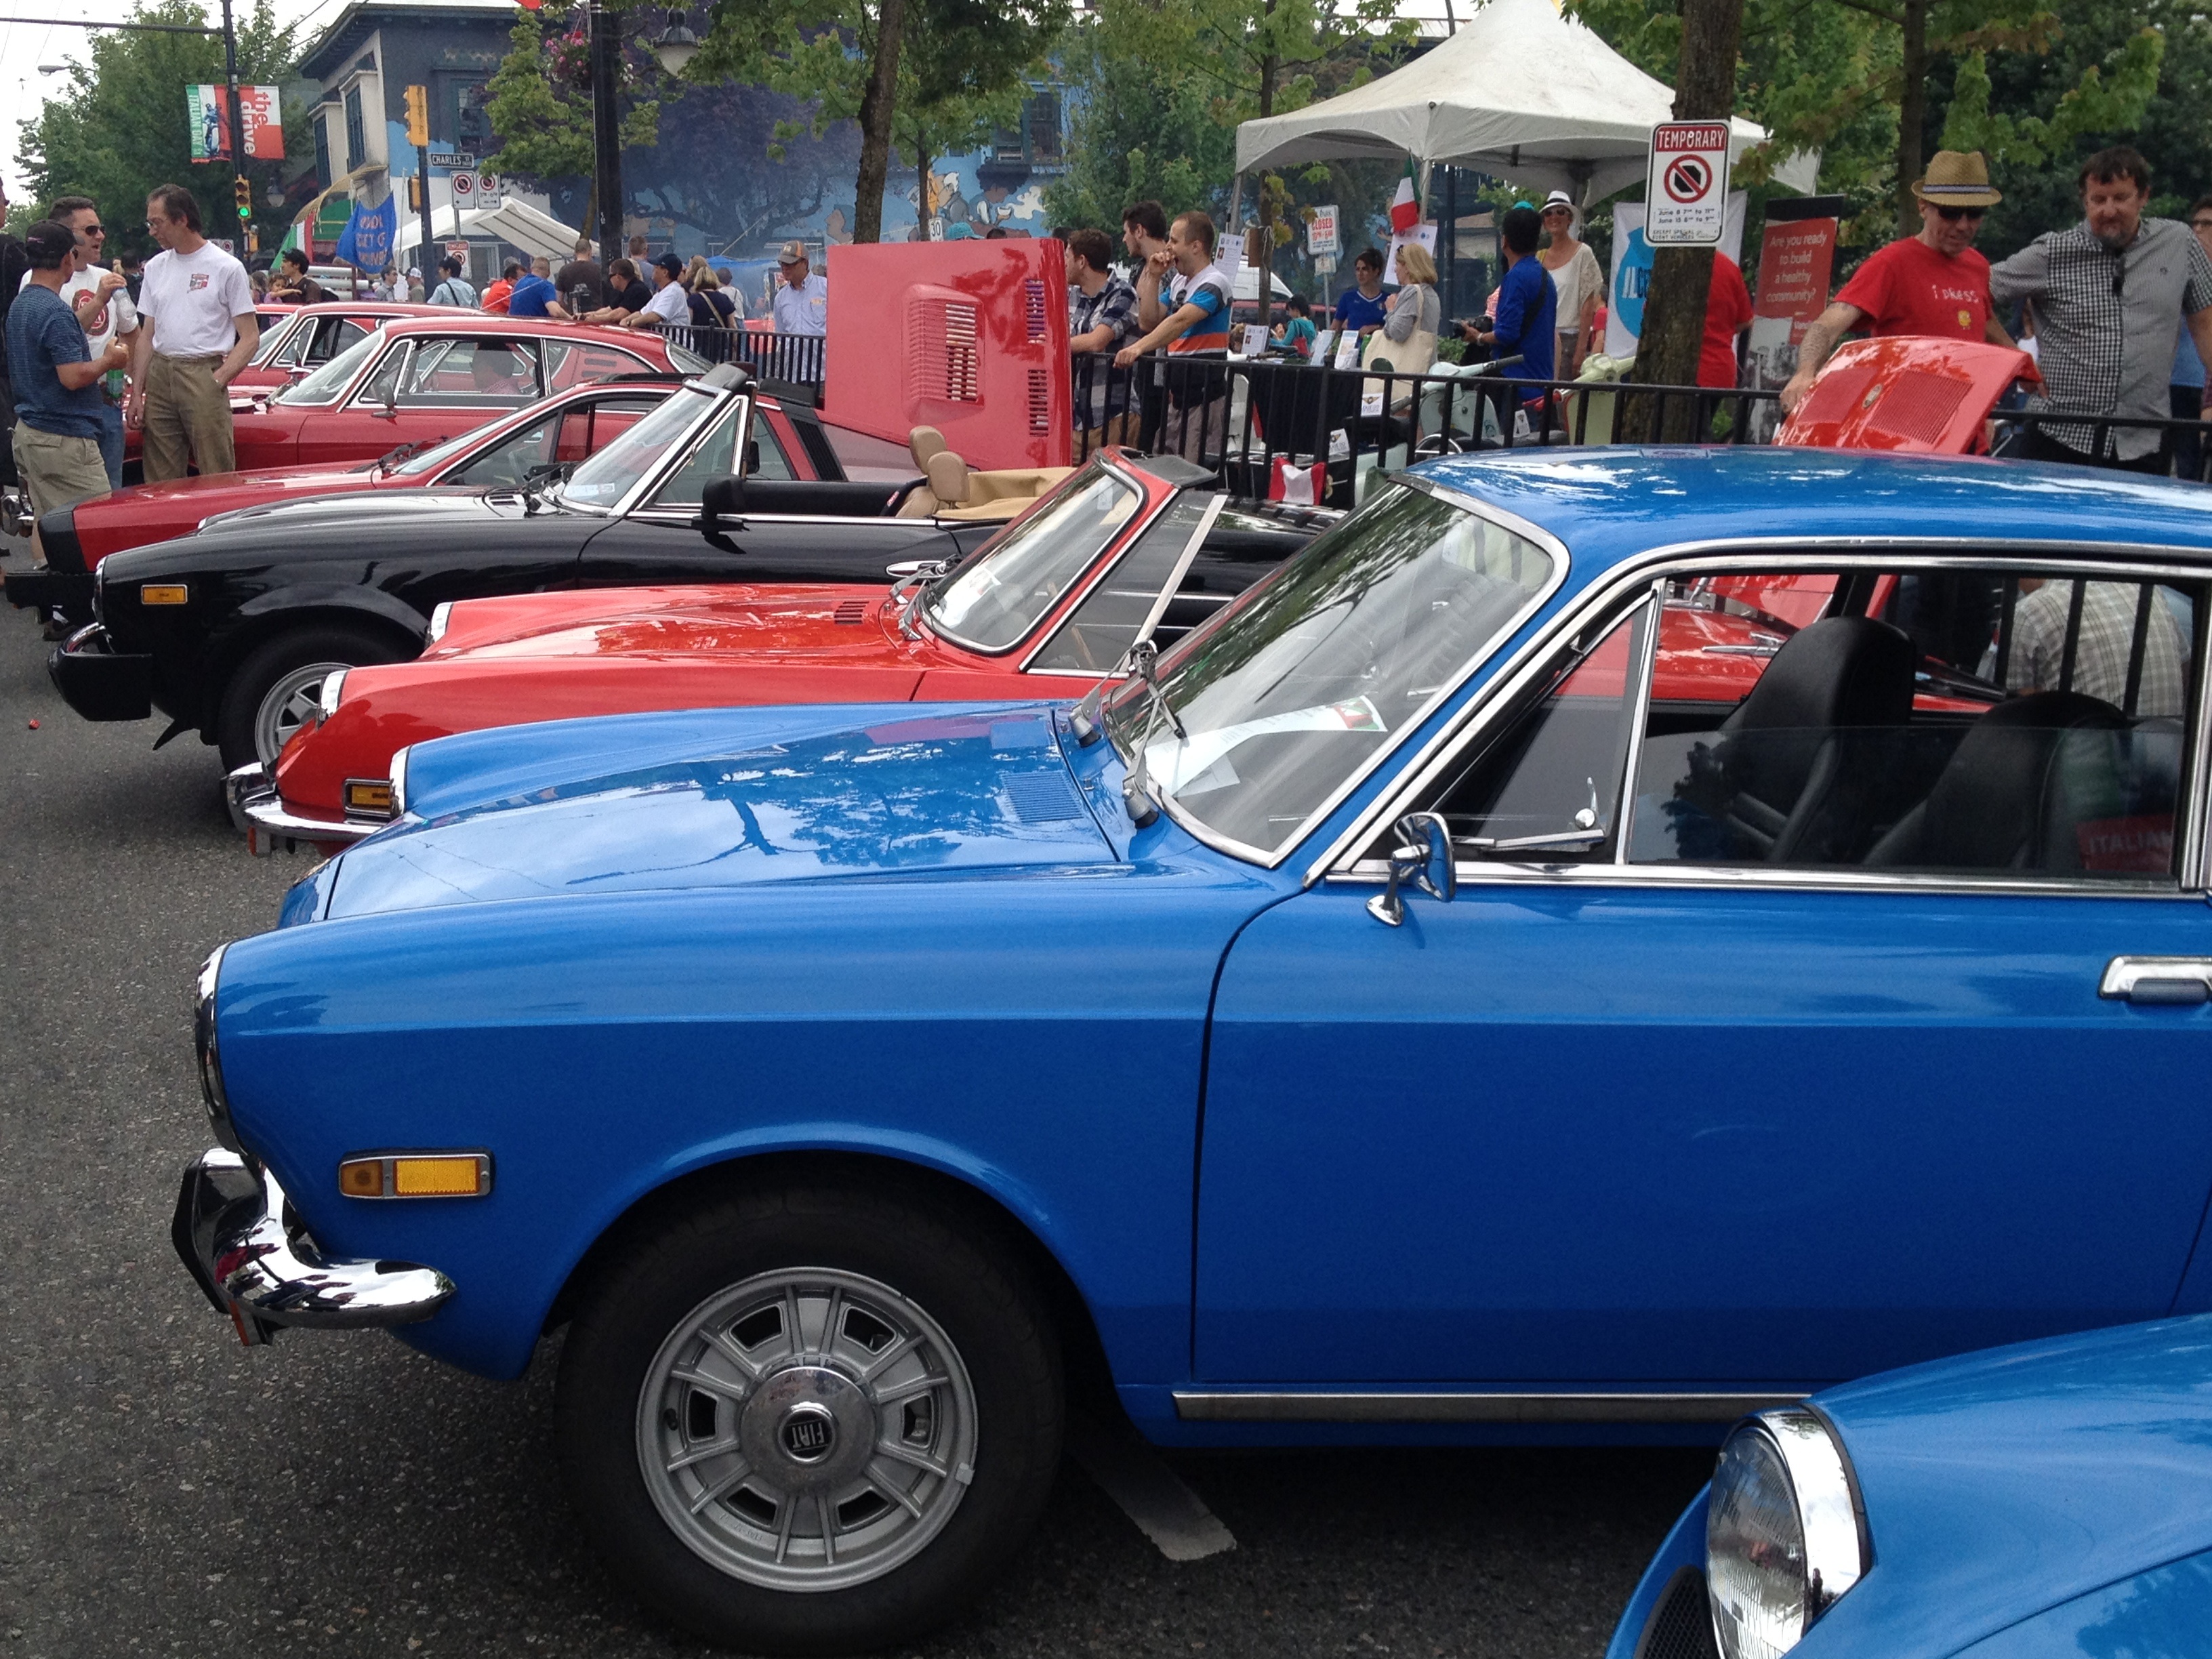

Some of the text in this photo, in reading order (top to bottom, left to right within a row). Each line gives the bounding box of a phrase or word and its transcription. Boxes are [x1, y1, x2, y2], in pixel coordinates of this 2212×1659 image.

[188, 95, 203, 130] ITALIAN
[255, 91, 271, 125] the
[241, 101, 258, 155] drive
[192, 131, 203, 146] DAY
[1658, 130, 1725, 148] TEMPORARY
[432, 155, 462, 165] CHARLES
[931, 221, 941, 237] 30
[1770, 230, 1828, 249] Are you ready
[1779, 249, 1812, 264] to build
[1775, 269, 1812, 285] a healthy
[1766, 287, 1816, 304] community?
[792, 1422, 825, 1448] FIAT
